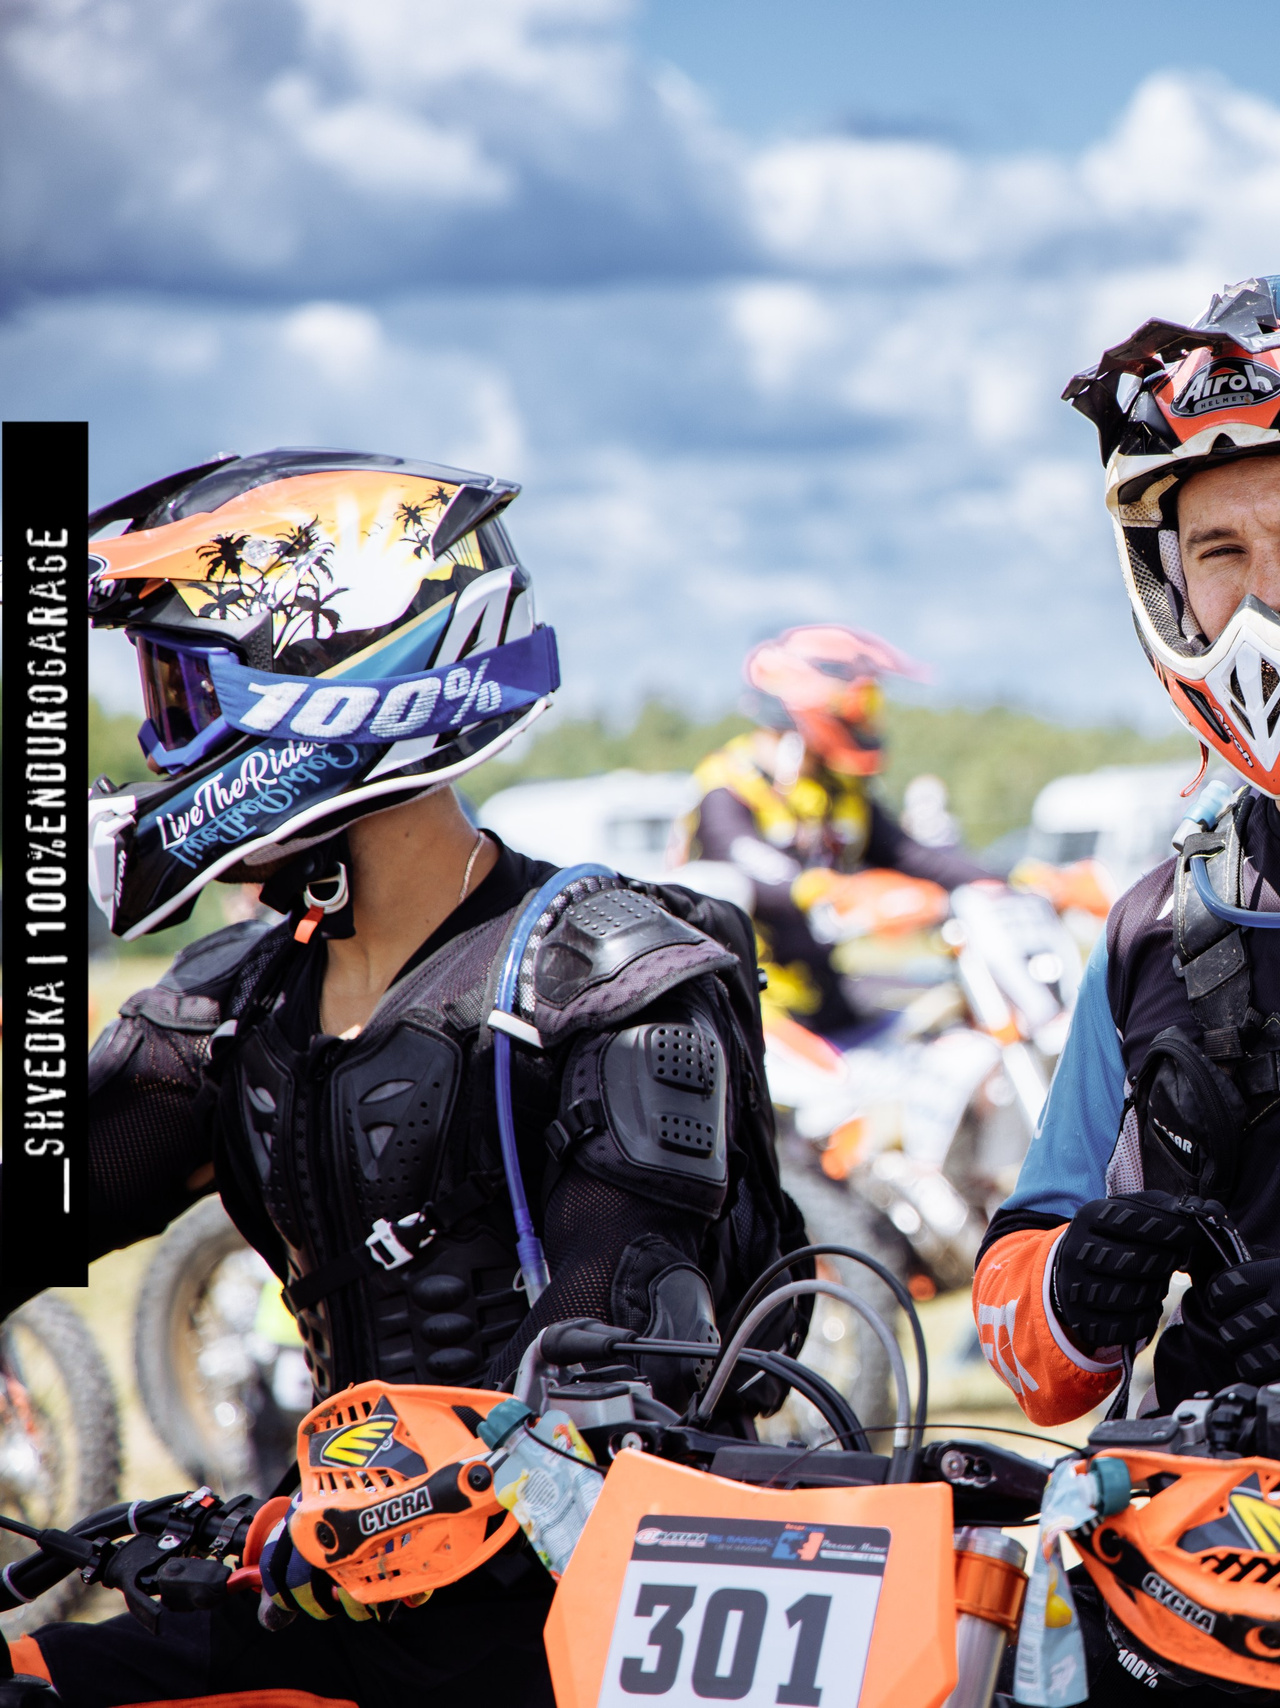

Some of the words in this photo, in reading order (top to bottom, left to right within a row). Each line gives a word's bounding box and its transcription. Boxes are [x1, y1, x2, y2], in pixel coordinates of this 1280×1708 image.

[1178, 364, 1274, 410] Airoh
[1200, 394, 1247, 409] HELMET
[239, 658, 503, 738] 100%
[358, 1485, 434, 1535] CYCRA
[1141, 1571, 1217, 1635] CYCRA
[619, 1583, 834, 1708] 301
